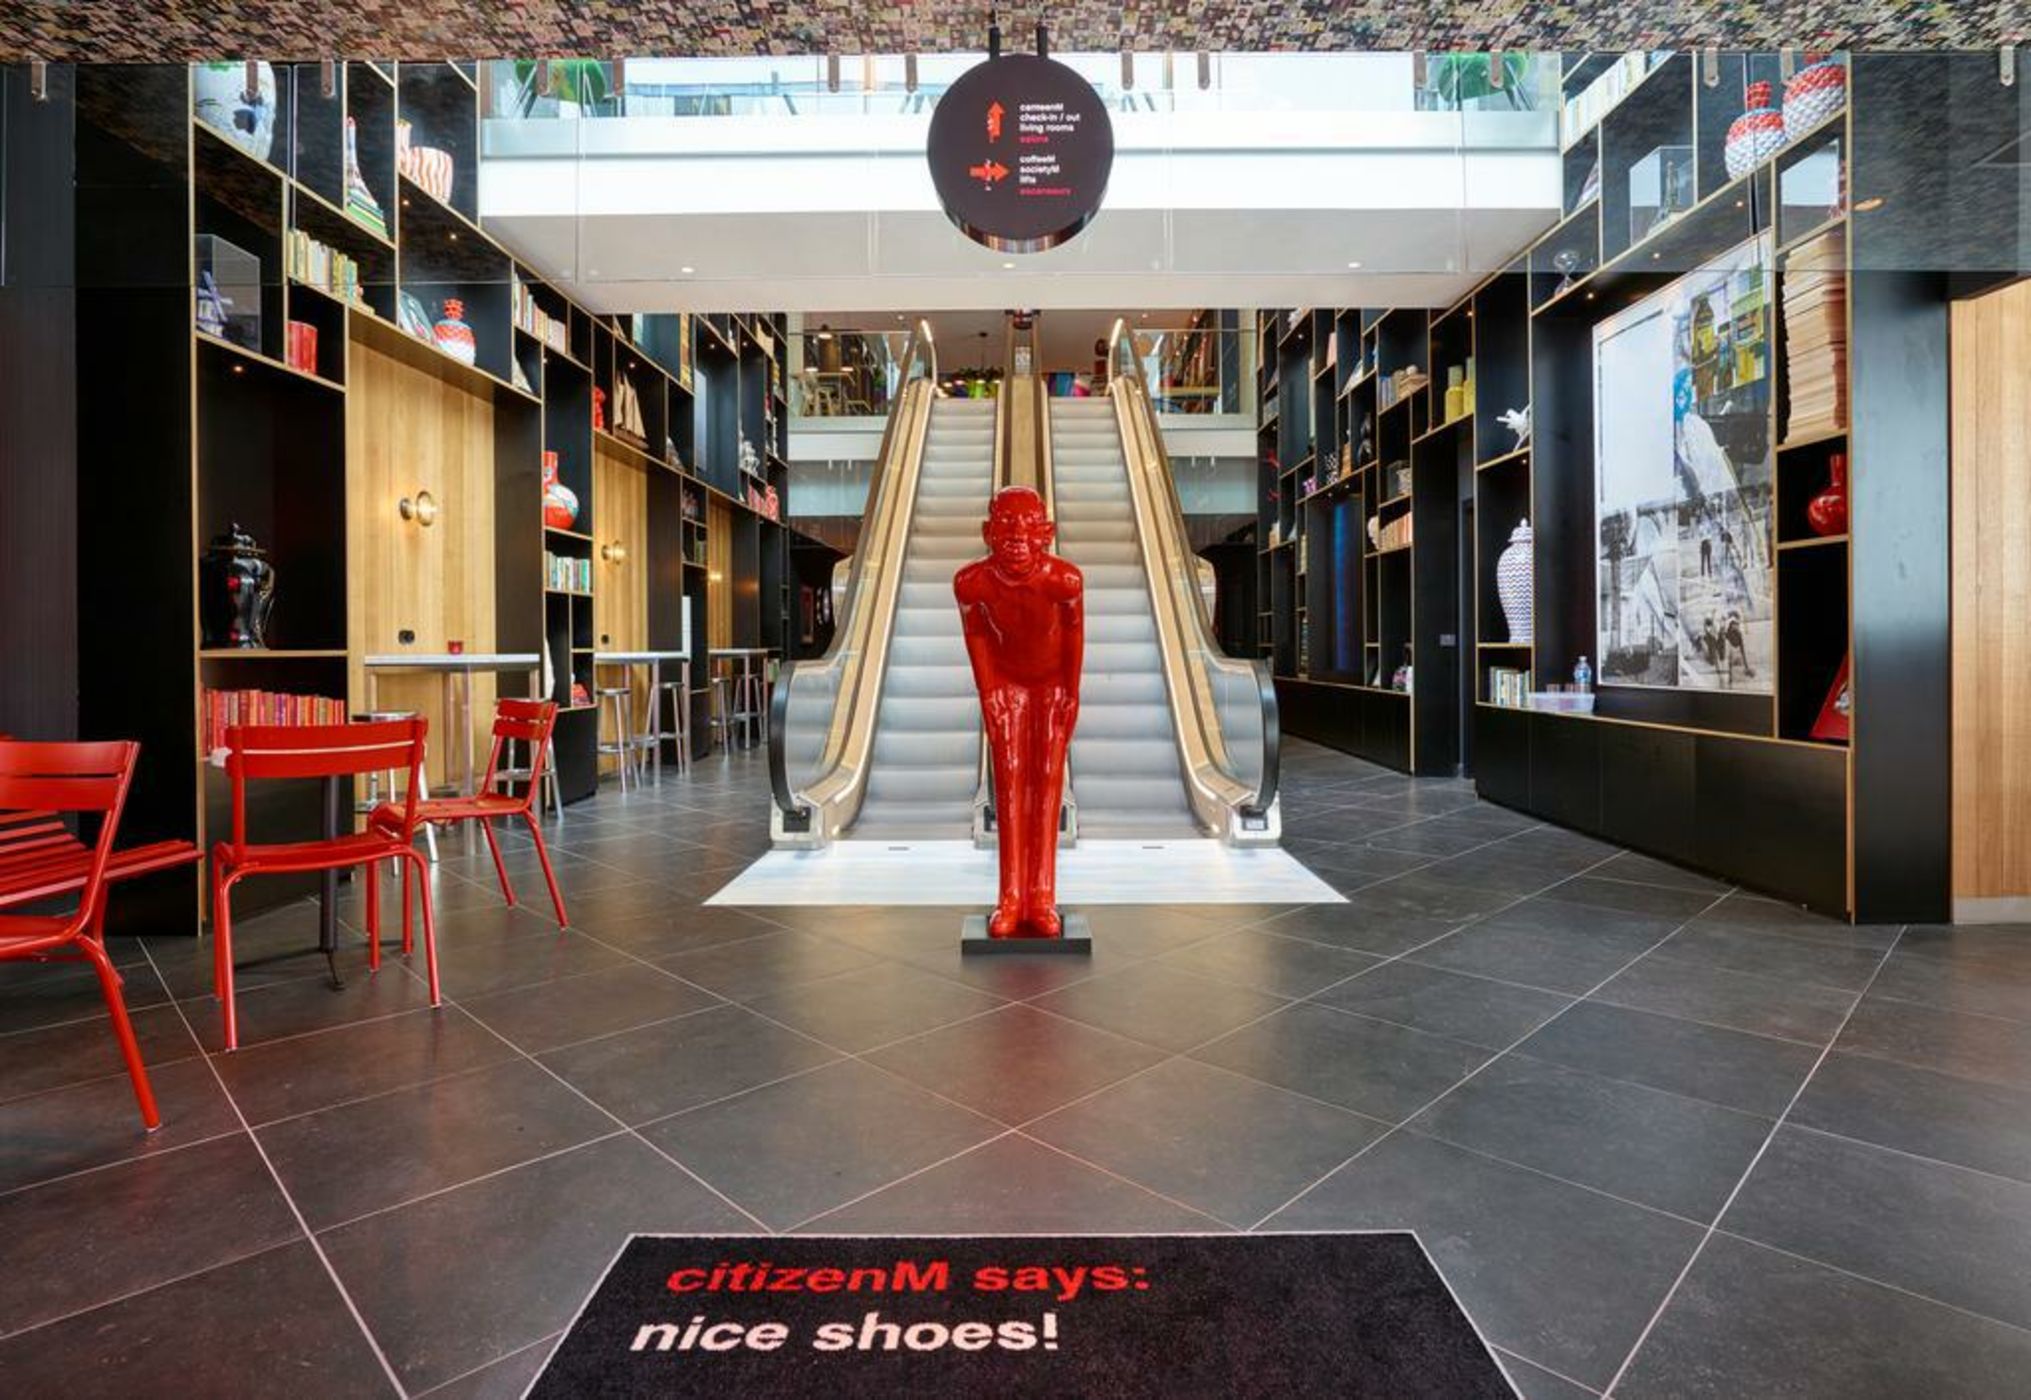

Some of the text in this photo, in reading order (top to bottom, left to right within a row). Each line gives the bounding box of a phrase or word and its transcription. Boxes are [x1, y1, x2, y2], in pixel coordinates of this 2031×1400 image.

[1019, 113, 1058, 122] check-in
[1065, 113, 1081, 122] out
[1019, 123, 1075, 134] living rooms
[666, 1259, 1150, 1302] citizenM says:
[630, 1312, 1058, 1351] nice shoes!
